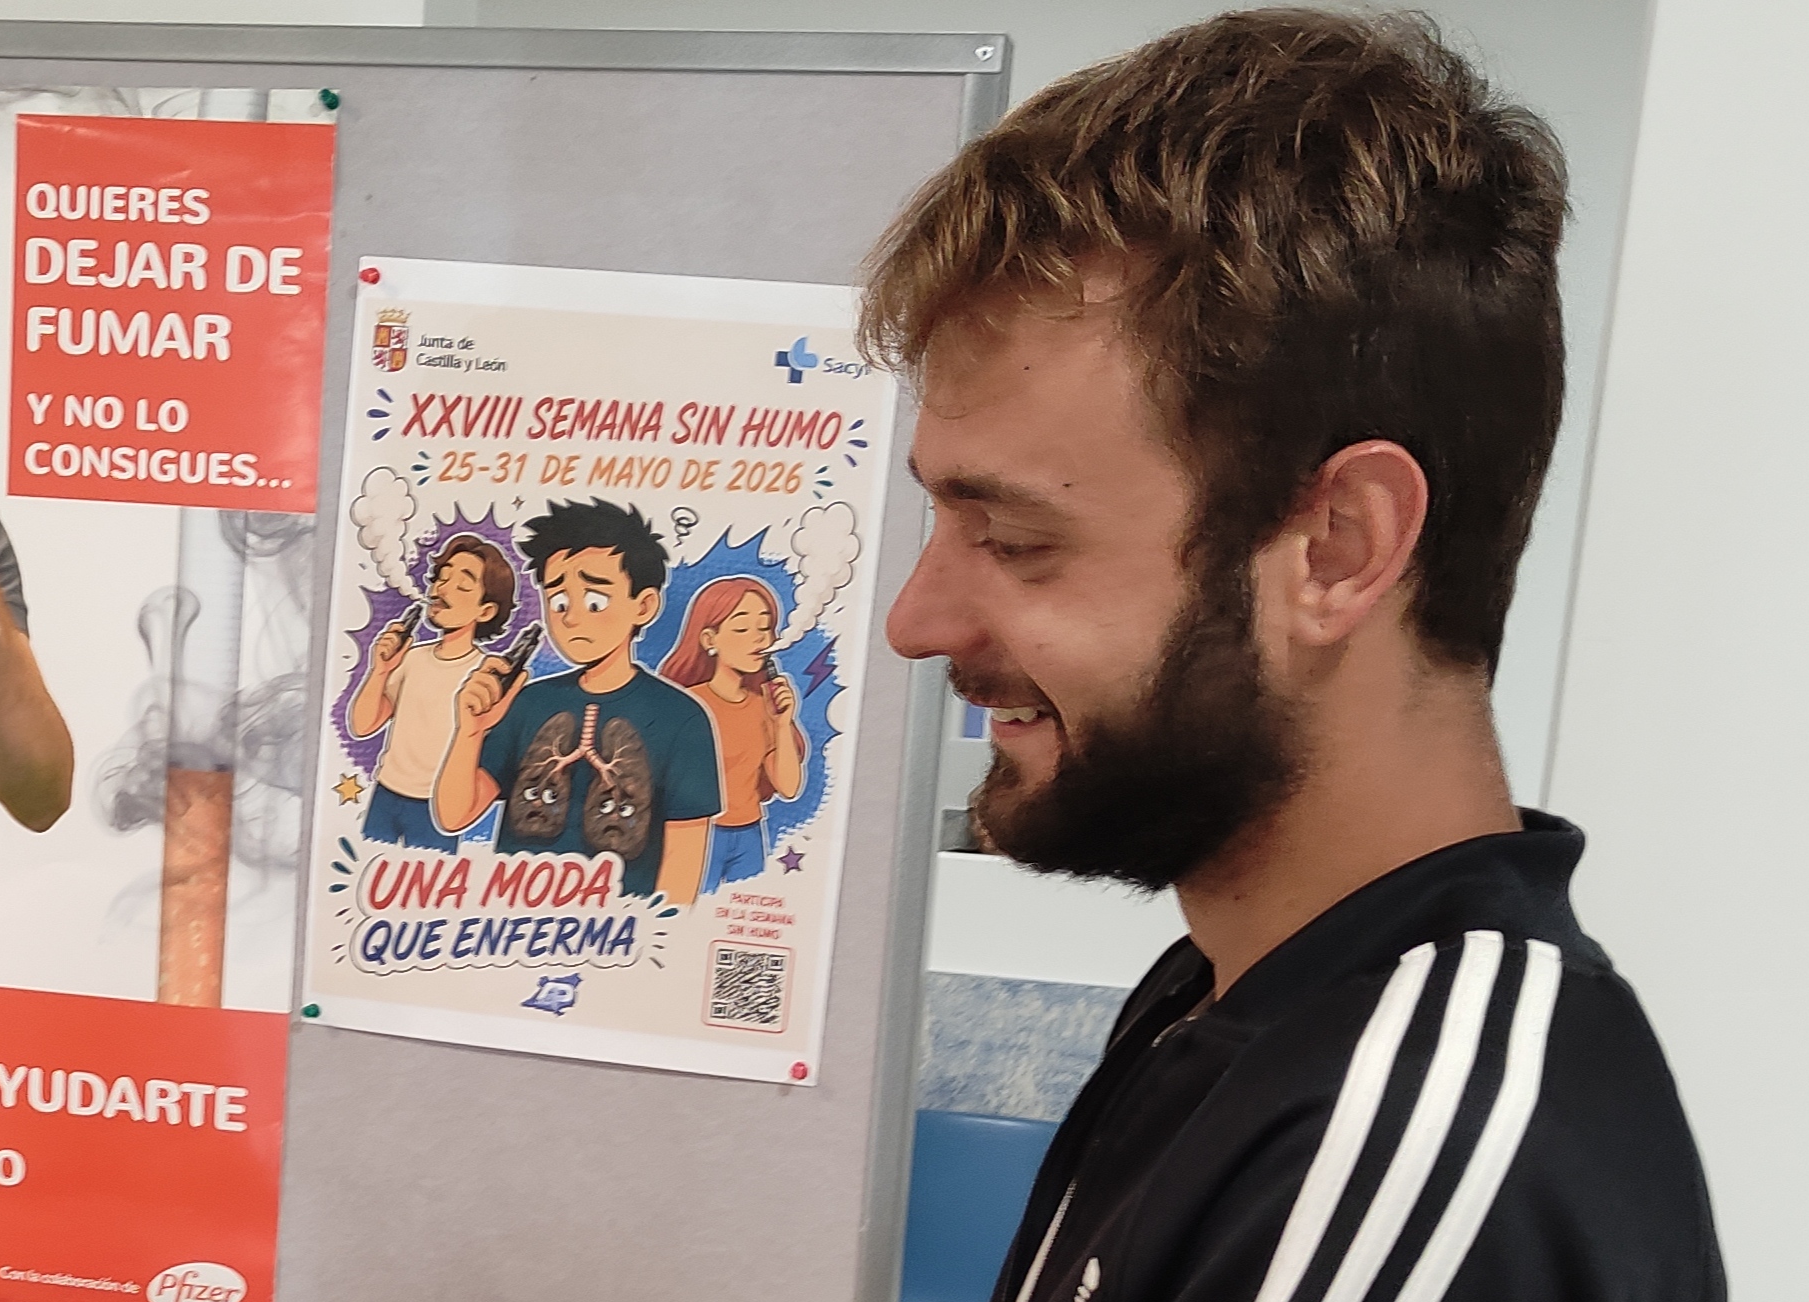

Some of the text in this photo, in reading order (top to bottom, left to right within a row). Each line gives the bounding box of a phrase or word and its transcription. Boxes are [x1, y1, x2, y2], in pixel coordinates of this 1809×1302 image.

[25, 182, 211, 225] QUIERES
[24, 237, 303, 295] DEJAR DE
[25, 306, 233, 362] FUMAR
[417, 333, 475, 350] Junta de
[416, 352, 508, 373] Castilla y León
[25, 393, 190, 433] Y NO LO
[401, 392, 844, 451] XXVIII SEMANA SIN HUMO
[23, 441, 293, 489] CONSIGUES...
[436, 450, 804, 495] 25-31 DE MAYO DE 2026
[368, 858, 615, 911] UNA MODA
[360, 915, 638, 966] QUE ENFERMA
